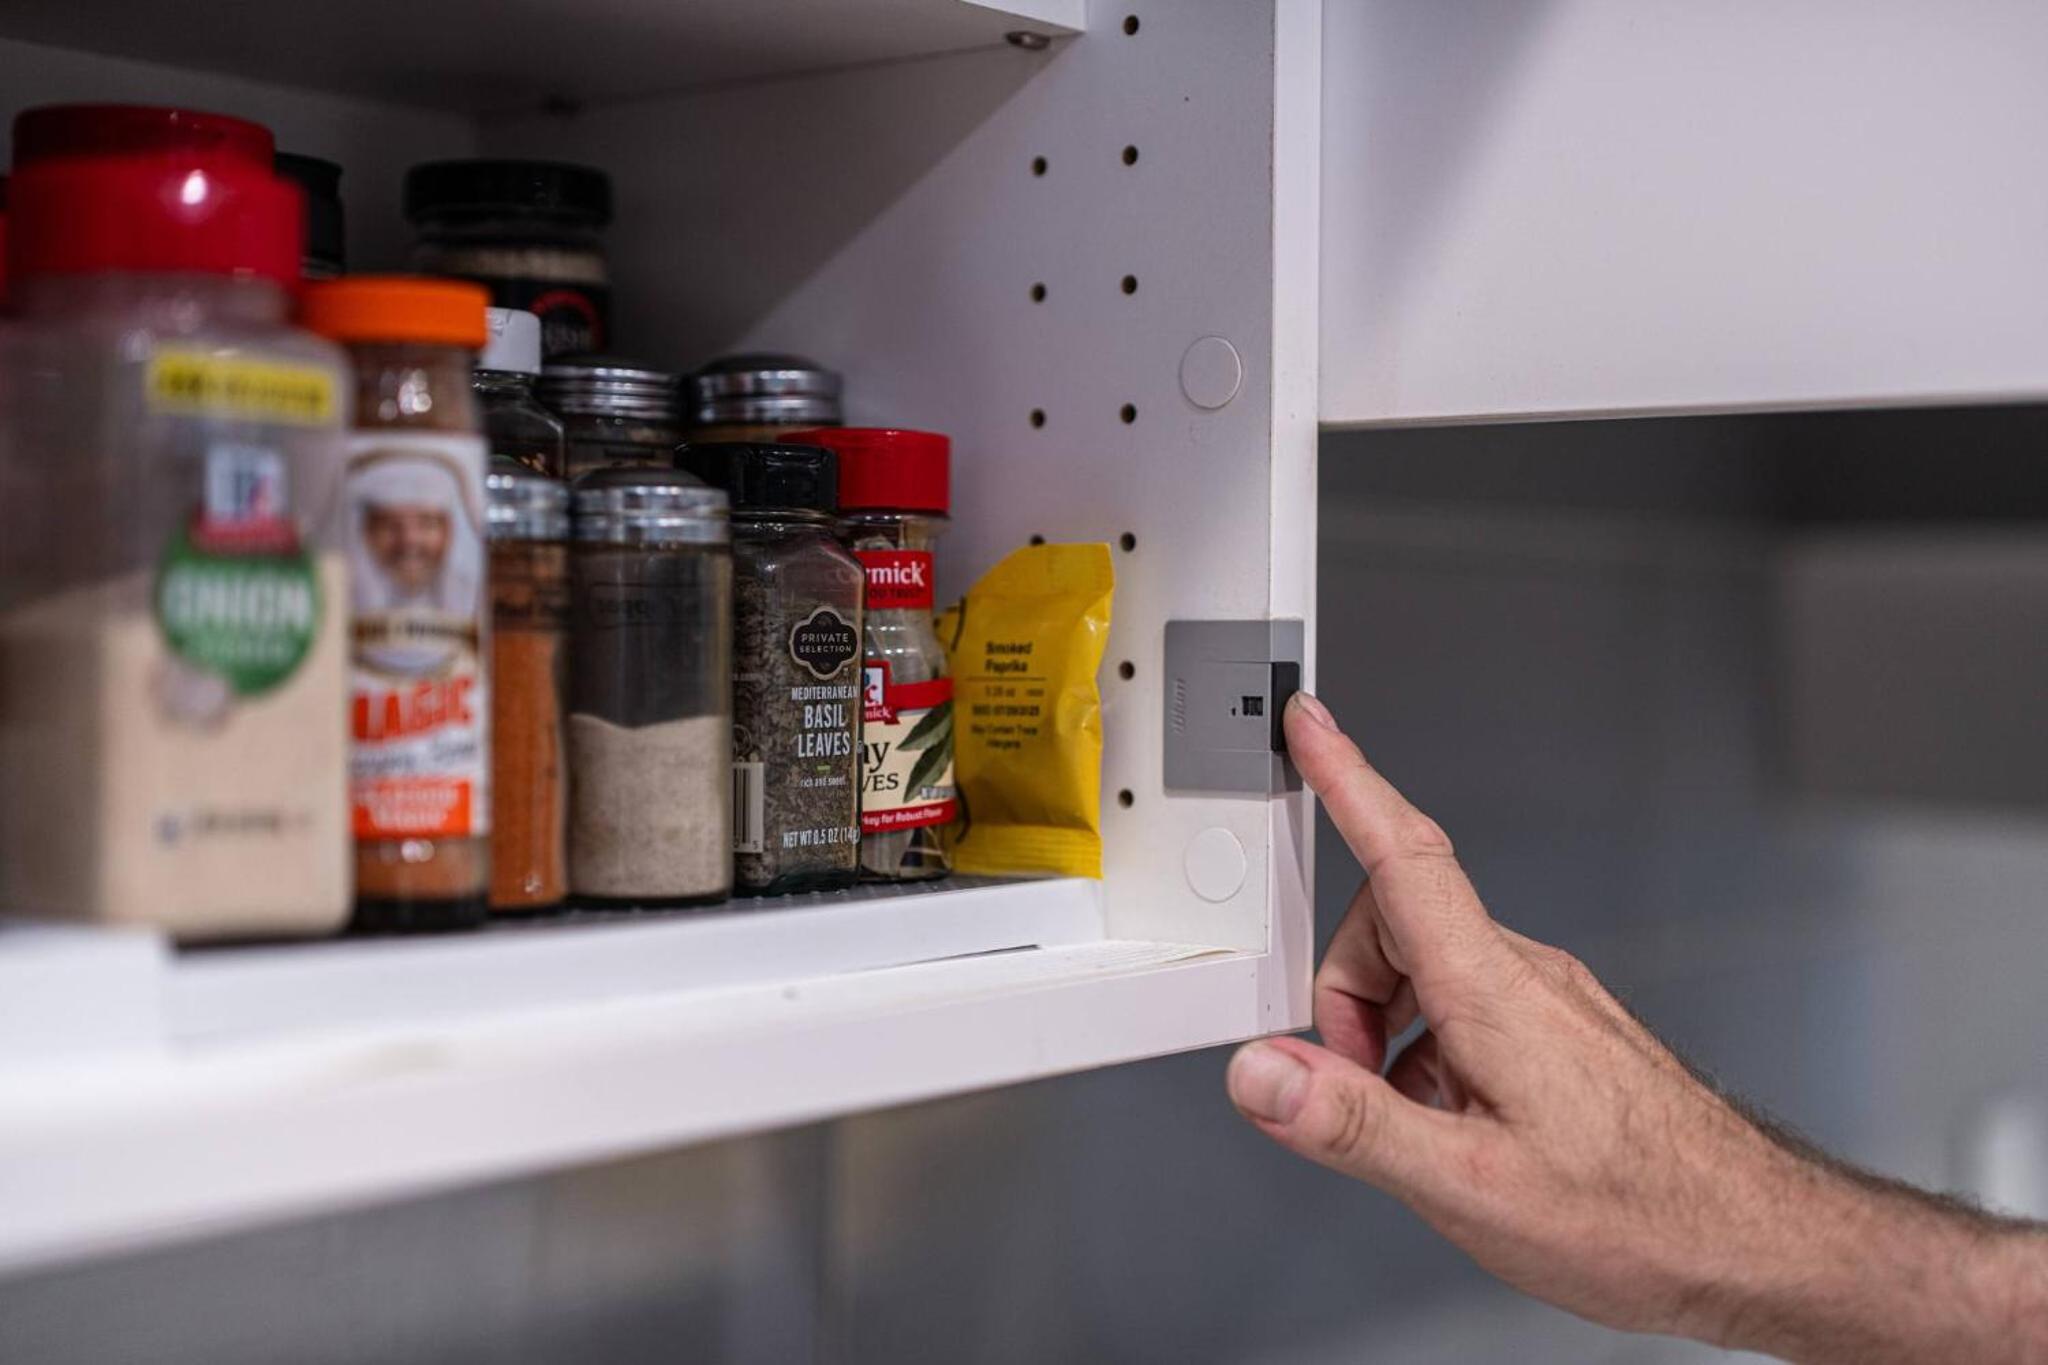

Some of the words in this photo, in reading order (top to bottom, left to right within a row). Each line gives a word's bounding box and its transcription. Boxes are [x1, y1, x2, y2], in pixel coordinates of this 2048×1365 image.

[800, 632, 849, 643] PRIVATE
[799, 644, 852, 653] SELECTION
[986, 641, 1034, 655] Smoked
[985, 659, 1028, 675] Paprika
[791, 685, 859, 700] MEDITERRANEAN
[804, 703, 848, 729] BASIL
[797, 731, 851, 758] LEAVES
[783, 831, 799, 848] NET
[800, 829, 813, 846] WT
[813, 828, 827, 845] 0.5
[828, 827, 838, 843] OZ
